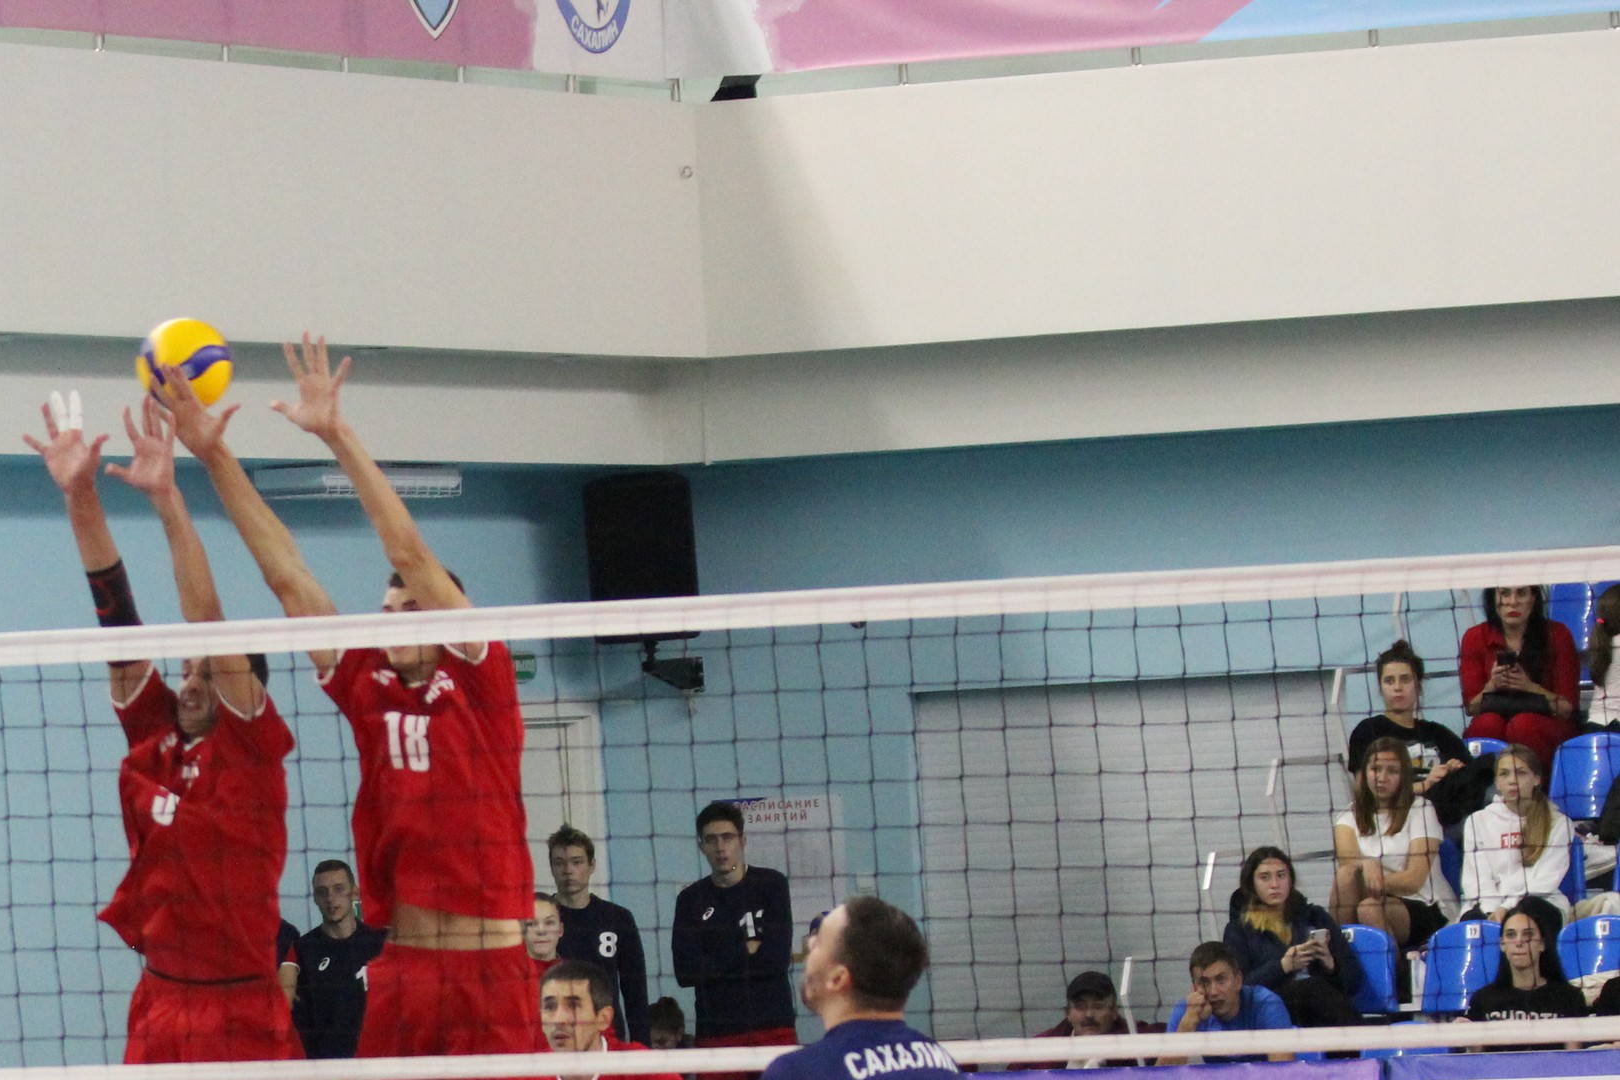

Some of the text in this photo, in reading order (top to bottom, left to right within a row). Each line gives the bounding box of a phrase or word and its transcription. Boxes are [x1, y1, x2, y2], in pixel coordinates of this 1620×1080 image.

[570, 15, 620, 49] САХАЛИН
[383, 711, 430, 772] 18
[748, 809, 807, 823] ЗАНЯТИЙ
[599, 932, 618, 958] 8
[355, 965, 368, 991] 1
[843, 1041, 960, 1080] САХАЛИН
